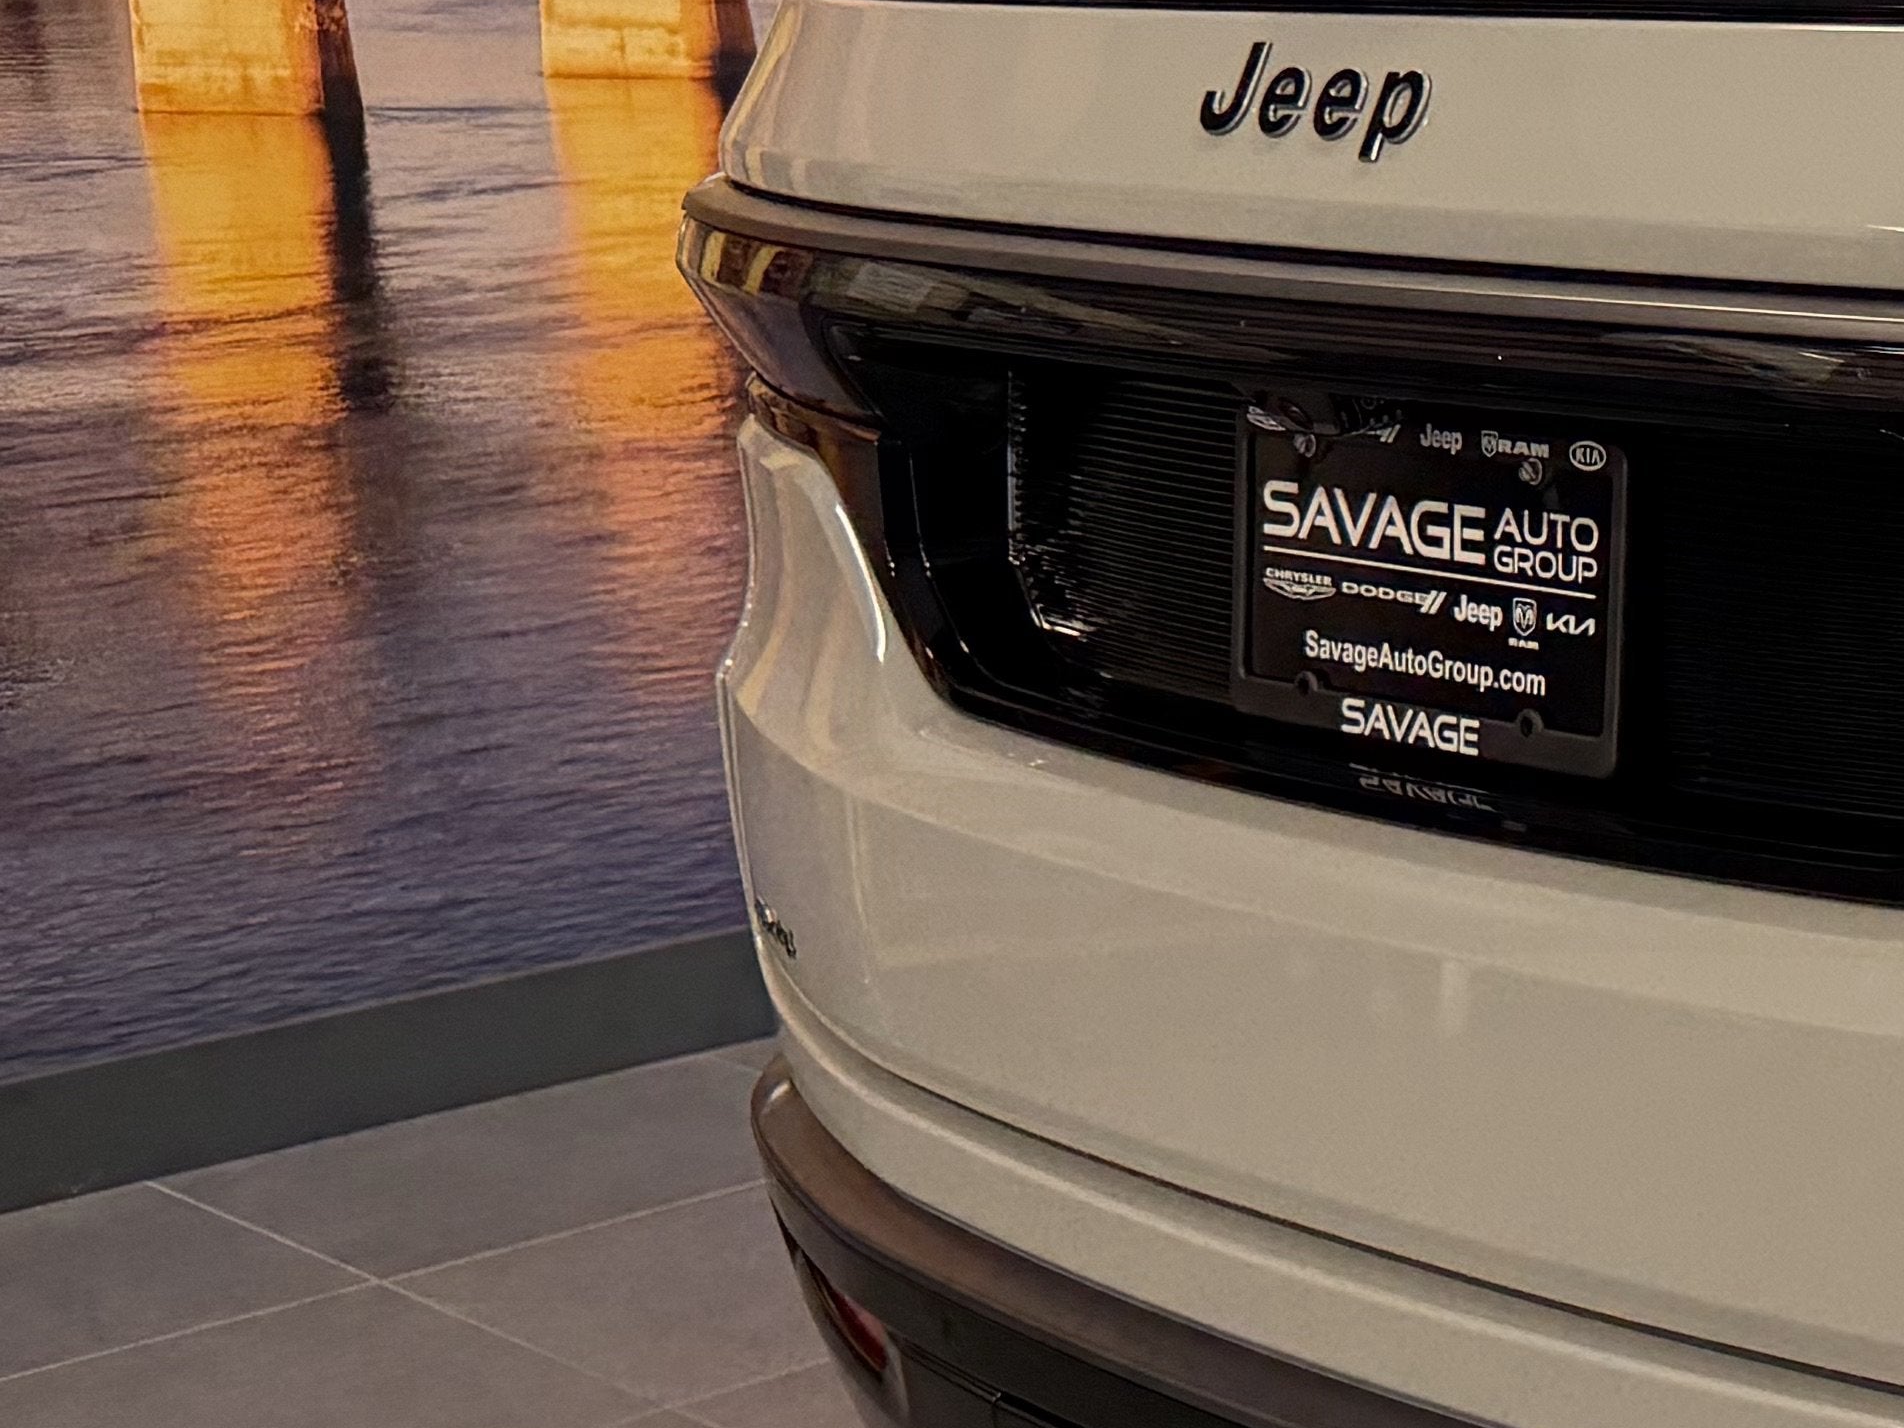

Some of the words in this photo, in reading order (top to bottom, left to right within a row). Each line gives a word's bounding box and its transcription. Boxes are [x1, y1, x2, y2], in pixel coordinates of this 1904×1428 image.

[1200, 42, 1432, 162] Jeep
[1420, 423, 1463, 455] Jeep
[1498, 439, 1549, 458] RAM
[1574, 446, 1602, 466] KIA
[1263, 480, 1487, 565] SAVAGE
[1494, 507, 1599, 552] AUTO
[1494, 546, 1598, 583] GROUP
[1266, 567, 1332, 587] CHRYSLER
[1342, 582, 1434, 606] DODGE
[1454, 594, 1503, 631] Jeep
[1305, 630, 1546, 696] SavageAutoGroup.com
[1341, 698, 1480, 756] SAVAGE
